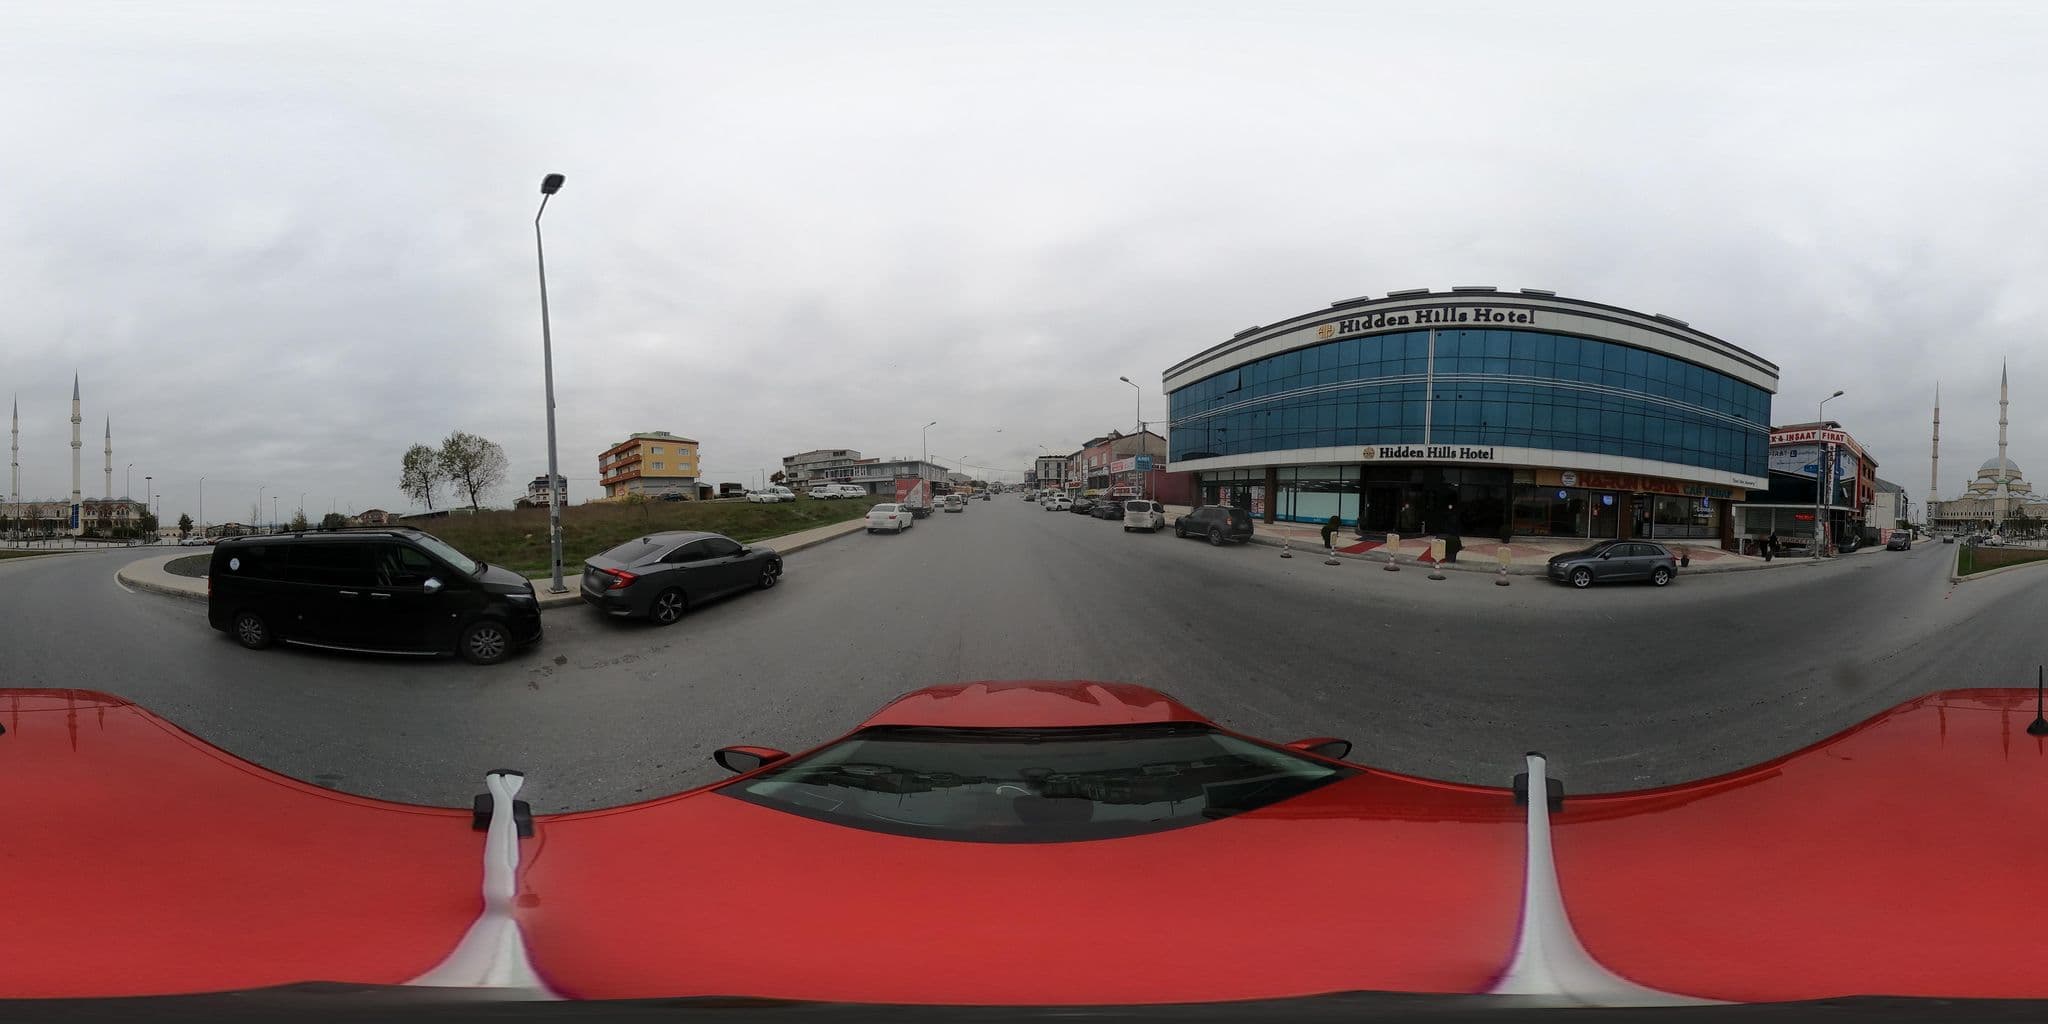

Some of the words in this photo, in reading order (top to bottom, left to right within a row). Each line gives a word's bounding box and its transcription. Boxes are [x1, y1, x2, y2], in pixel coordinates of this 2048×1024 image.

[1338, 312, 1410, 334] Hidden
[1415, 307, 1467, 324] Hills
[1474, 307, 1536, 324] Hotel
[1822, 431, 1844, 441] FIRAT
[1379, 446, 1424, 459] Hidden
[1427, 446, 1457, 459] Hills
[1460, 447, 1494, 460] Hotel
